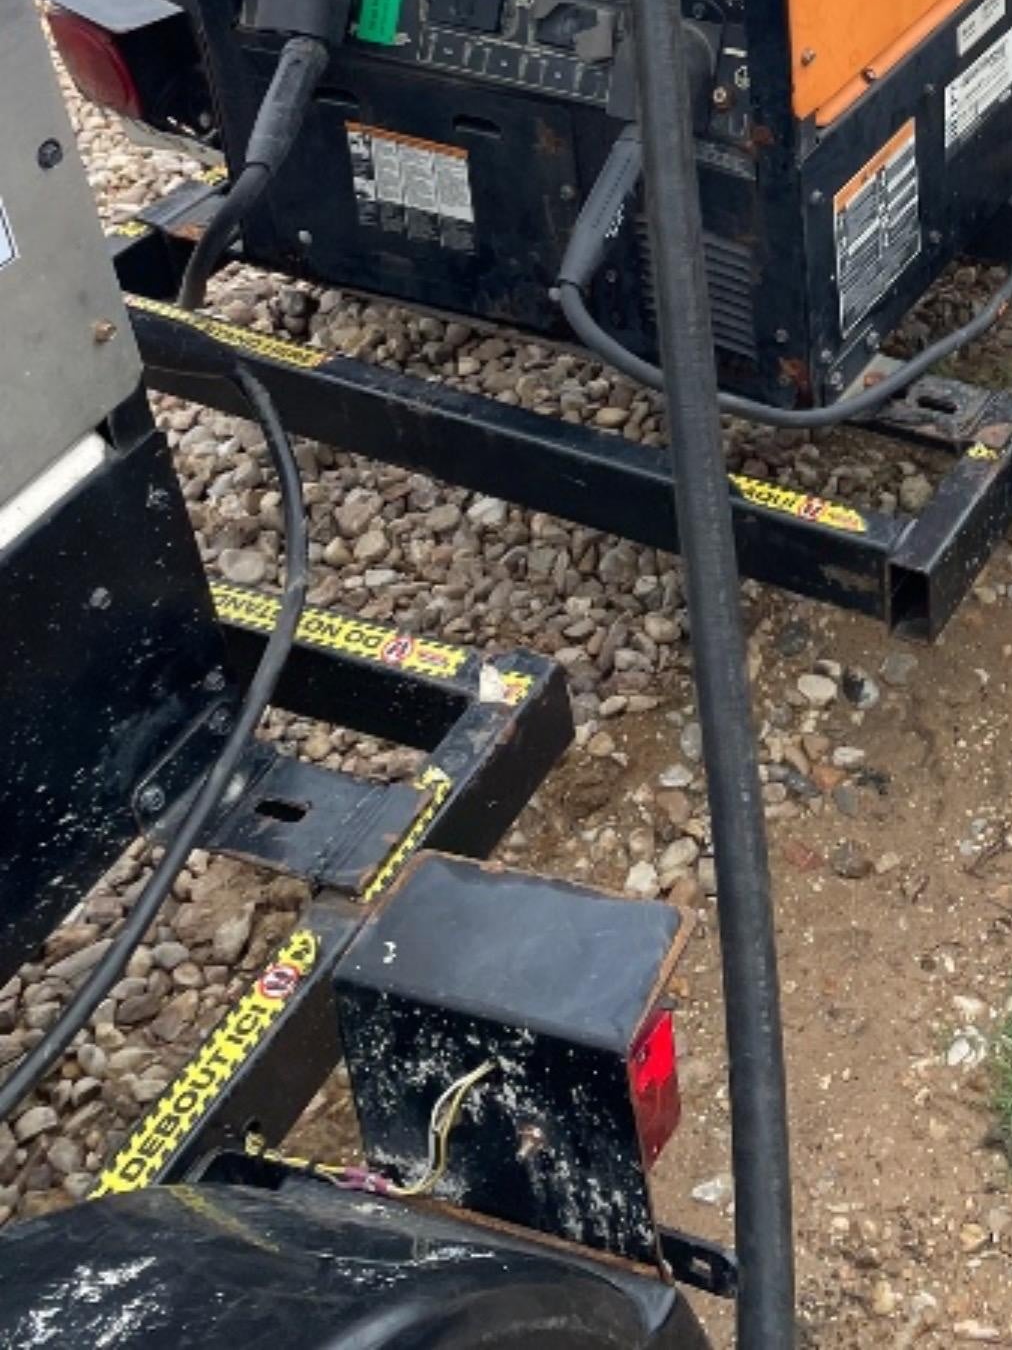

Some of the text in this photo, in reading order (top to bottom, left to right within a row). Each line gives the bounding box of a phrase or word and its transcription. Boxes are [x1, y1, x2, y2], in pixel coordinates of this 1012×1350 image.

[305, 616, 342, 642] NO
[344, 630, 382, 650] DO
[120, 1003, 268, 1183] DEBOUT ICI
